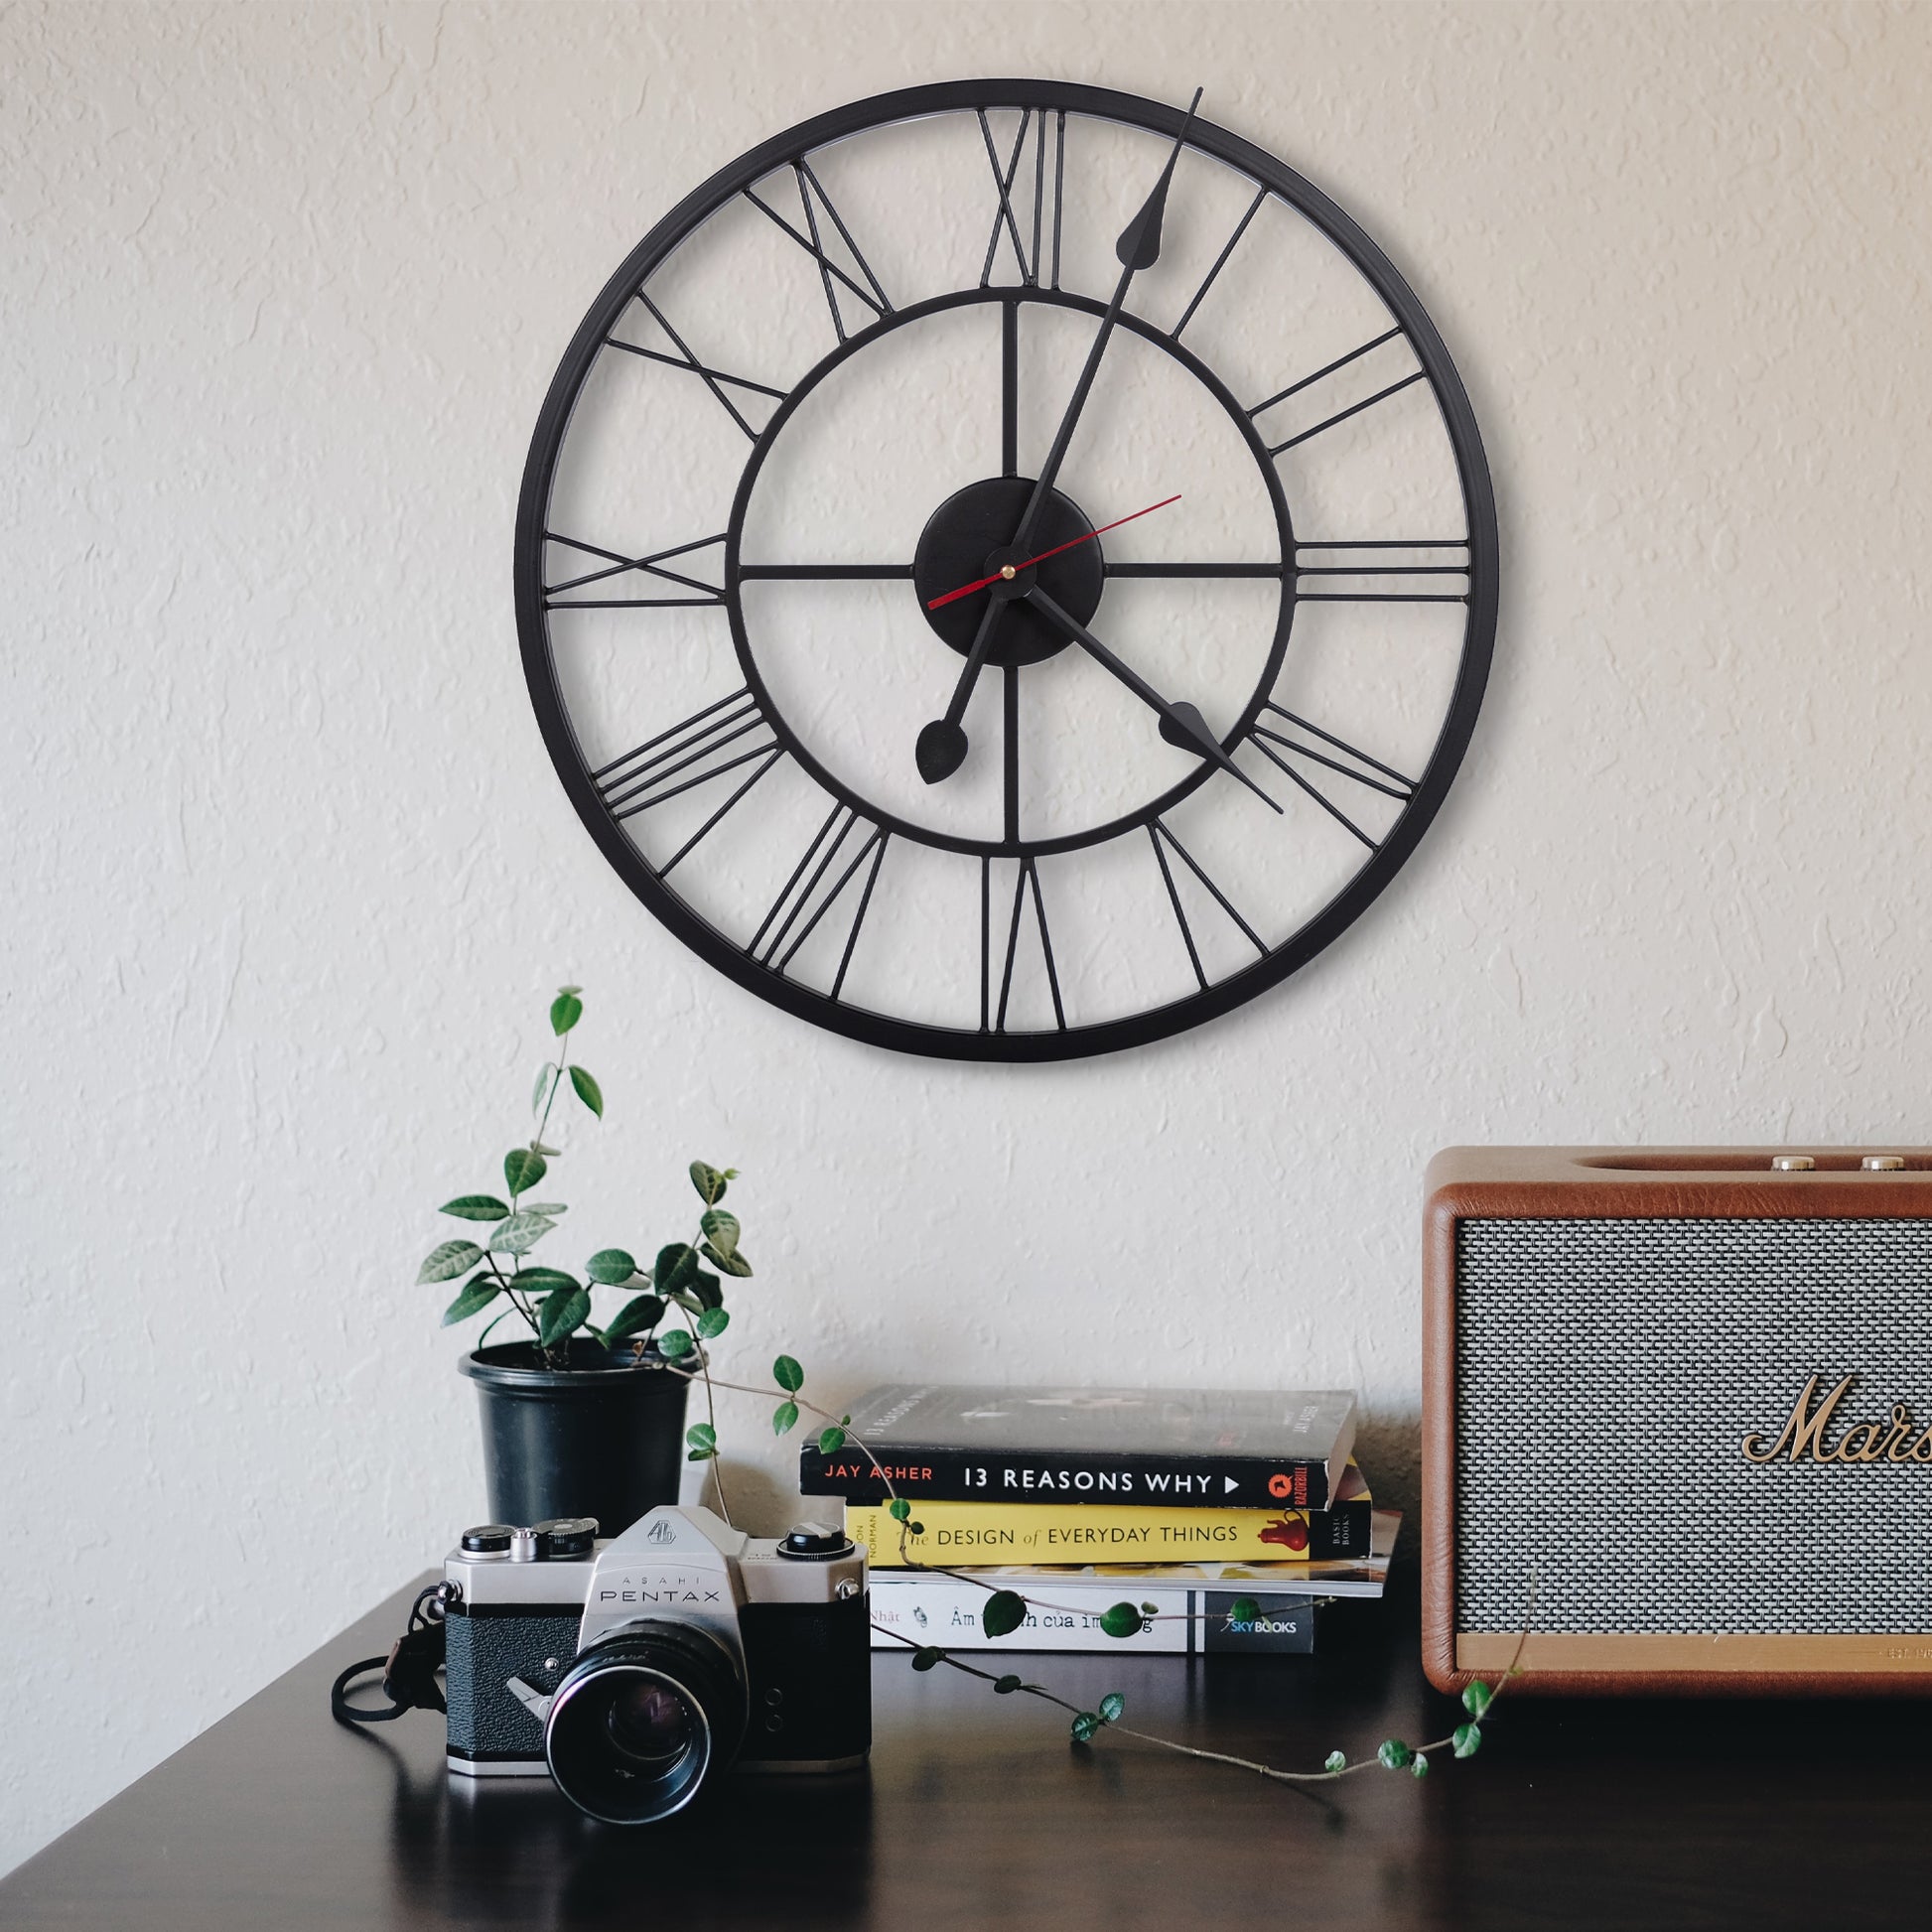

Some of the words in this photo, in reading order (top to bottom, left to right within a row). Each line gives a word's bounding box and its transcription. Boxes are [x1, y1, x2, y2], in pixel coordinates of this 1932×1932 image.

[978, 108, 1065, 290] XII
[825, 1464, 862, 1478] JAY
[870, 1465, 932, 1481] ASHER
[964, 1467, 988, 1487] 13
[1004, 1469, 1134, 1491] REASONS
[1145, 1473, 1212, 1494] WHY
[1294, 1466, 1308, 1505] RAZORBILL
[938, 1529, 1015, 1546] DESIGN
[1023, 1528, 1041, 1550] of
[1047, 1525, 1152, 1544] EVERYDAY
[1159, 1525, 1239, 1542] THINGS
[1341, 1513, 1350, 1546] BOOKS
[601, 1590, 720, 1602] PENTAX
[951, 1606, 975, 1626] Âm
[1042, 1610, 1075, 1628] của
